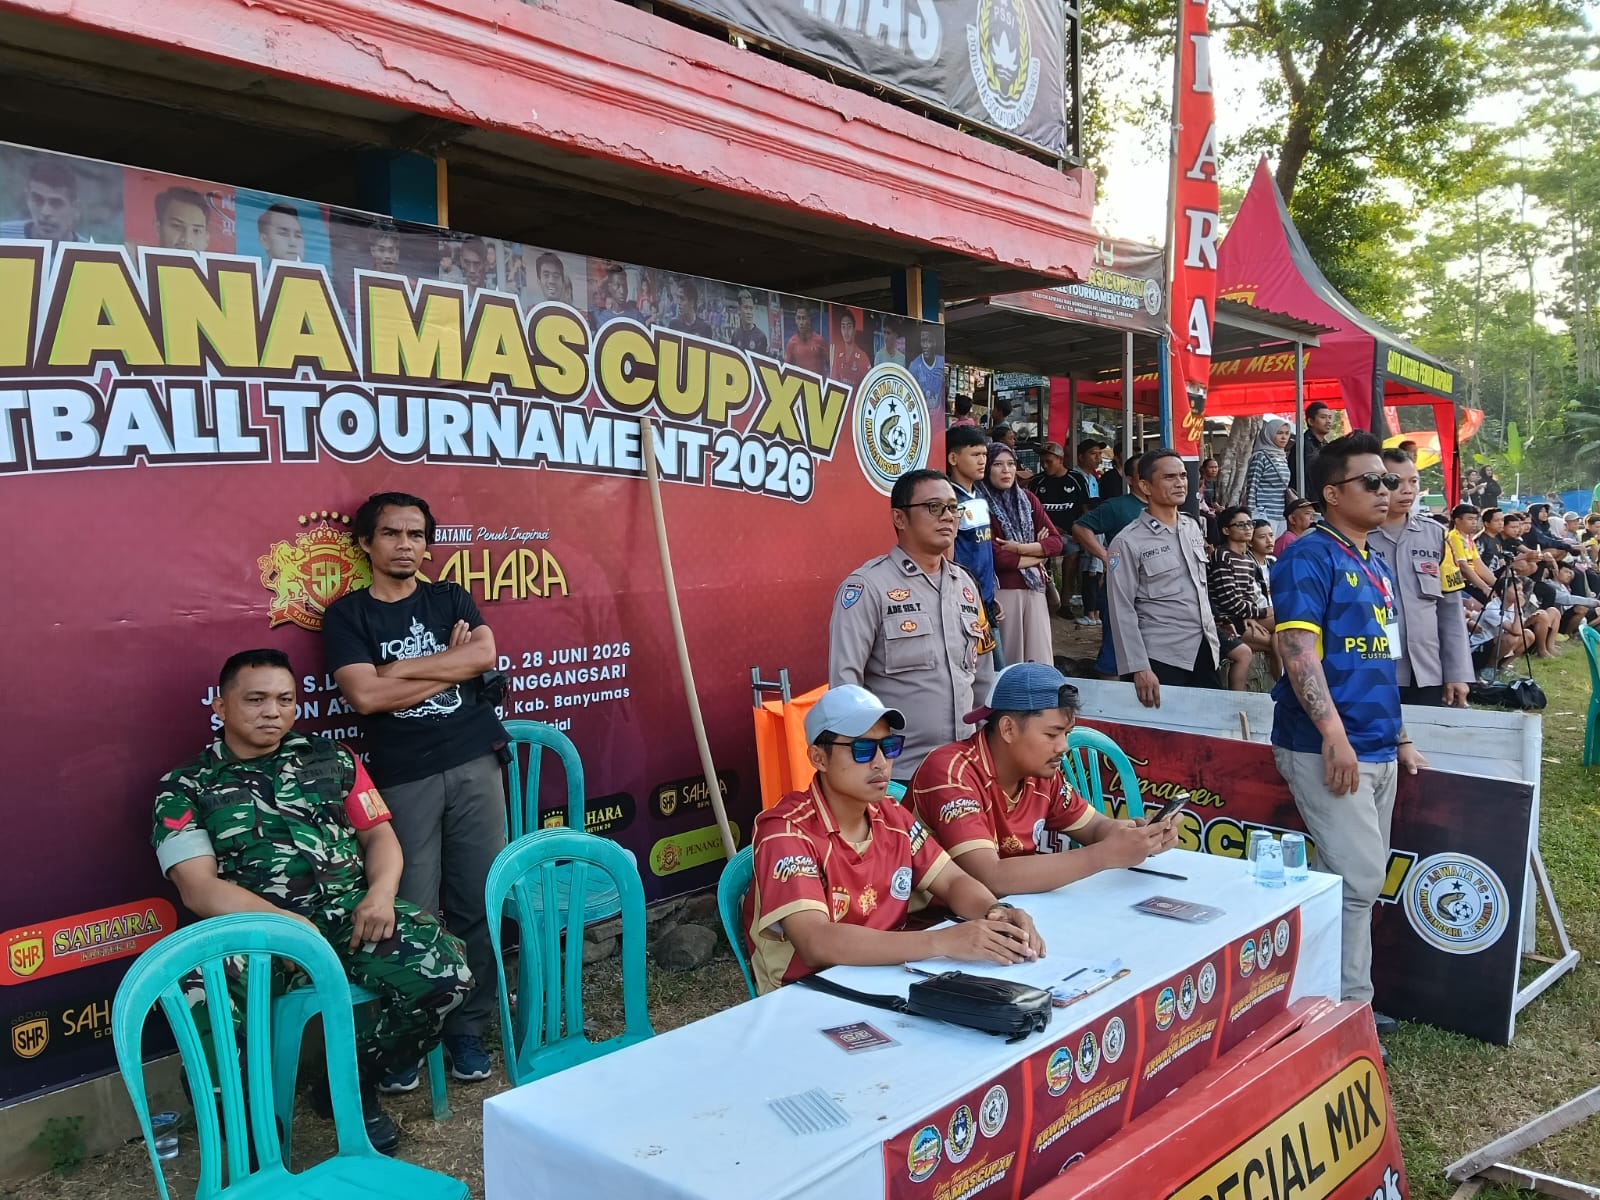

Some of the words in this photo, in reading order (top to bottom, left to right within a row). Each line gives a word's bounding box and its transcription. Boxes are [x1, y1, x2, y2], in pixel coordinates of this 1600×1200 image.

[368, 285, 589, 396] MAS
[600, 329, 752, 424] CUP
[757, 365, 845, 451] XV
[275, 387, 709, 478] TOURNAMENT
[714, 436, 811, 497] 2026
[434, 528, 472, 542] BATANG
[1411, 549, 1441, 561] POLRI
[522, 651, 543, 669] 28
[548, 646, 588, 666] JUNI
[592, 641, 631, 661] 2026
[1345, 636, 1368, 654] PS
[1372, 636, 1389, 653] AP
[511, 663, 627, 692] NGGANGSARI
[514, 698, 549, 714] Kab.
[554, 687, 631, 708] Banyumas
[683, 779, 728, 804] SAHA
[585, 804, 623, 826] HARA
[1426, 865, 1474, 885] ARWANA
[1473, 877, 1490, 894] FC
[833, 898, 846, 916] HR
[13, 944, 41, 969] SHR
[53, 908, 163, 957] SAHARA
[17, 1027, 44, 1050] SHR
[62, 1000, 110, 1037] SAH
[1324, 1070, 1382, 1164] MIX
[952, 1174, 977, 1198] MAS
[977, 1160, 999, 1182] CUP
